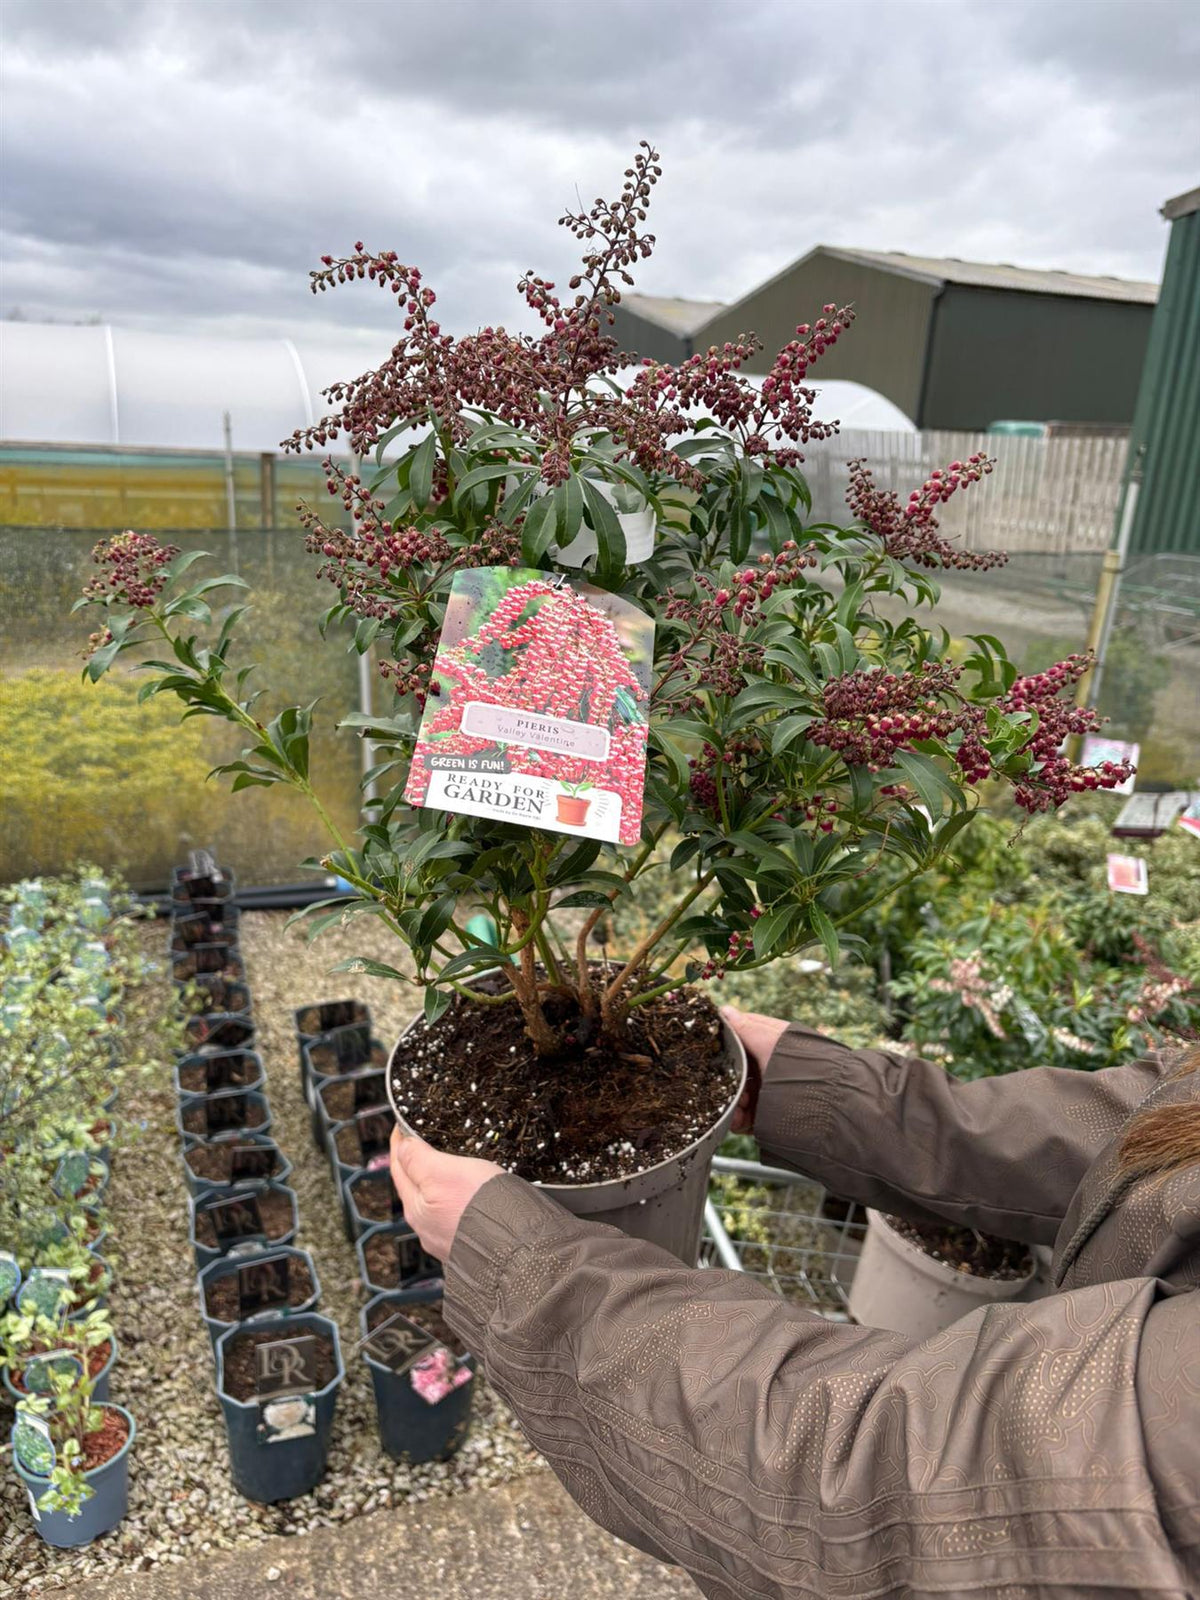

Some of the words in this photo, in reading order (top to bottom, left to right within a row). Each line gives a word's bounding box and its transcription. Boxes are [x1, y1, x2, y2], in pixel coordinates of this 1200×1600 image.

[497, 725, 526, 739] Valley
[530, 731, 576, 747] Valentine
[517, 719, 560, 735] PIERIS
[431, 756, 466, 769] GREEN
[468, 758, 478, 769] IS
[481, 759, 505, 771] FUN!
[447, 772, 503, 791] READY
[513, 784, 546, 799] FOR
[443, 783, 545, 814] GARDEN
